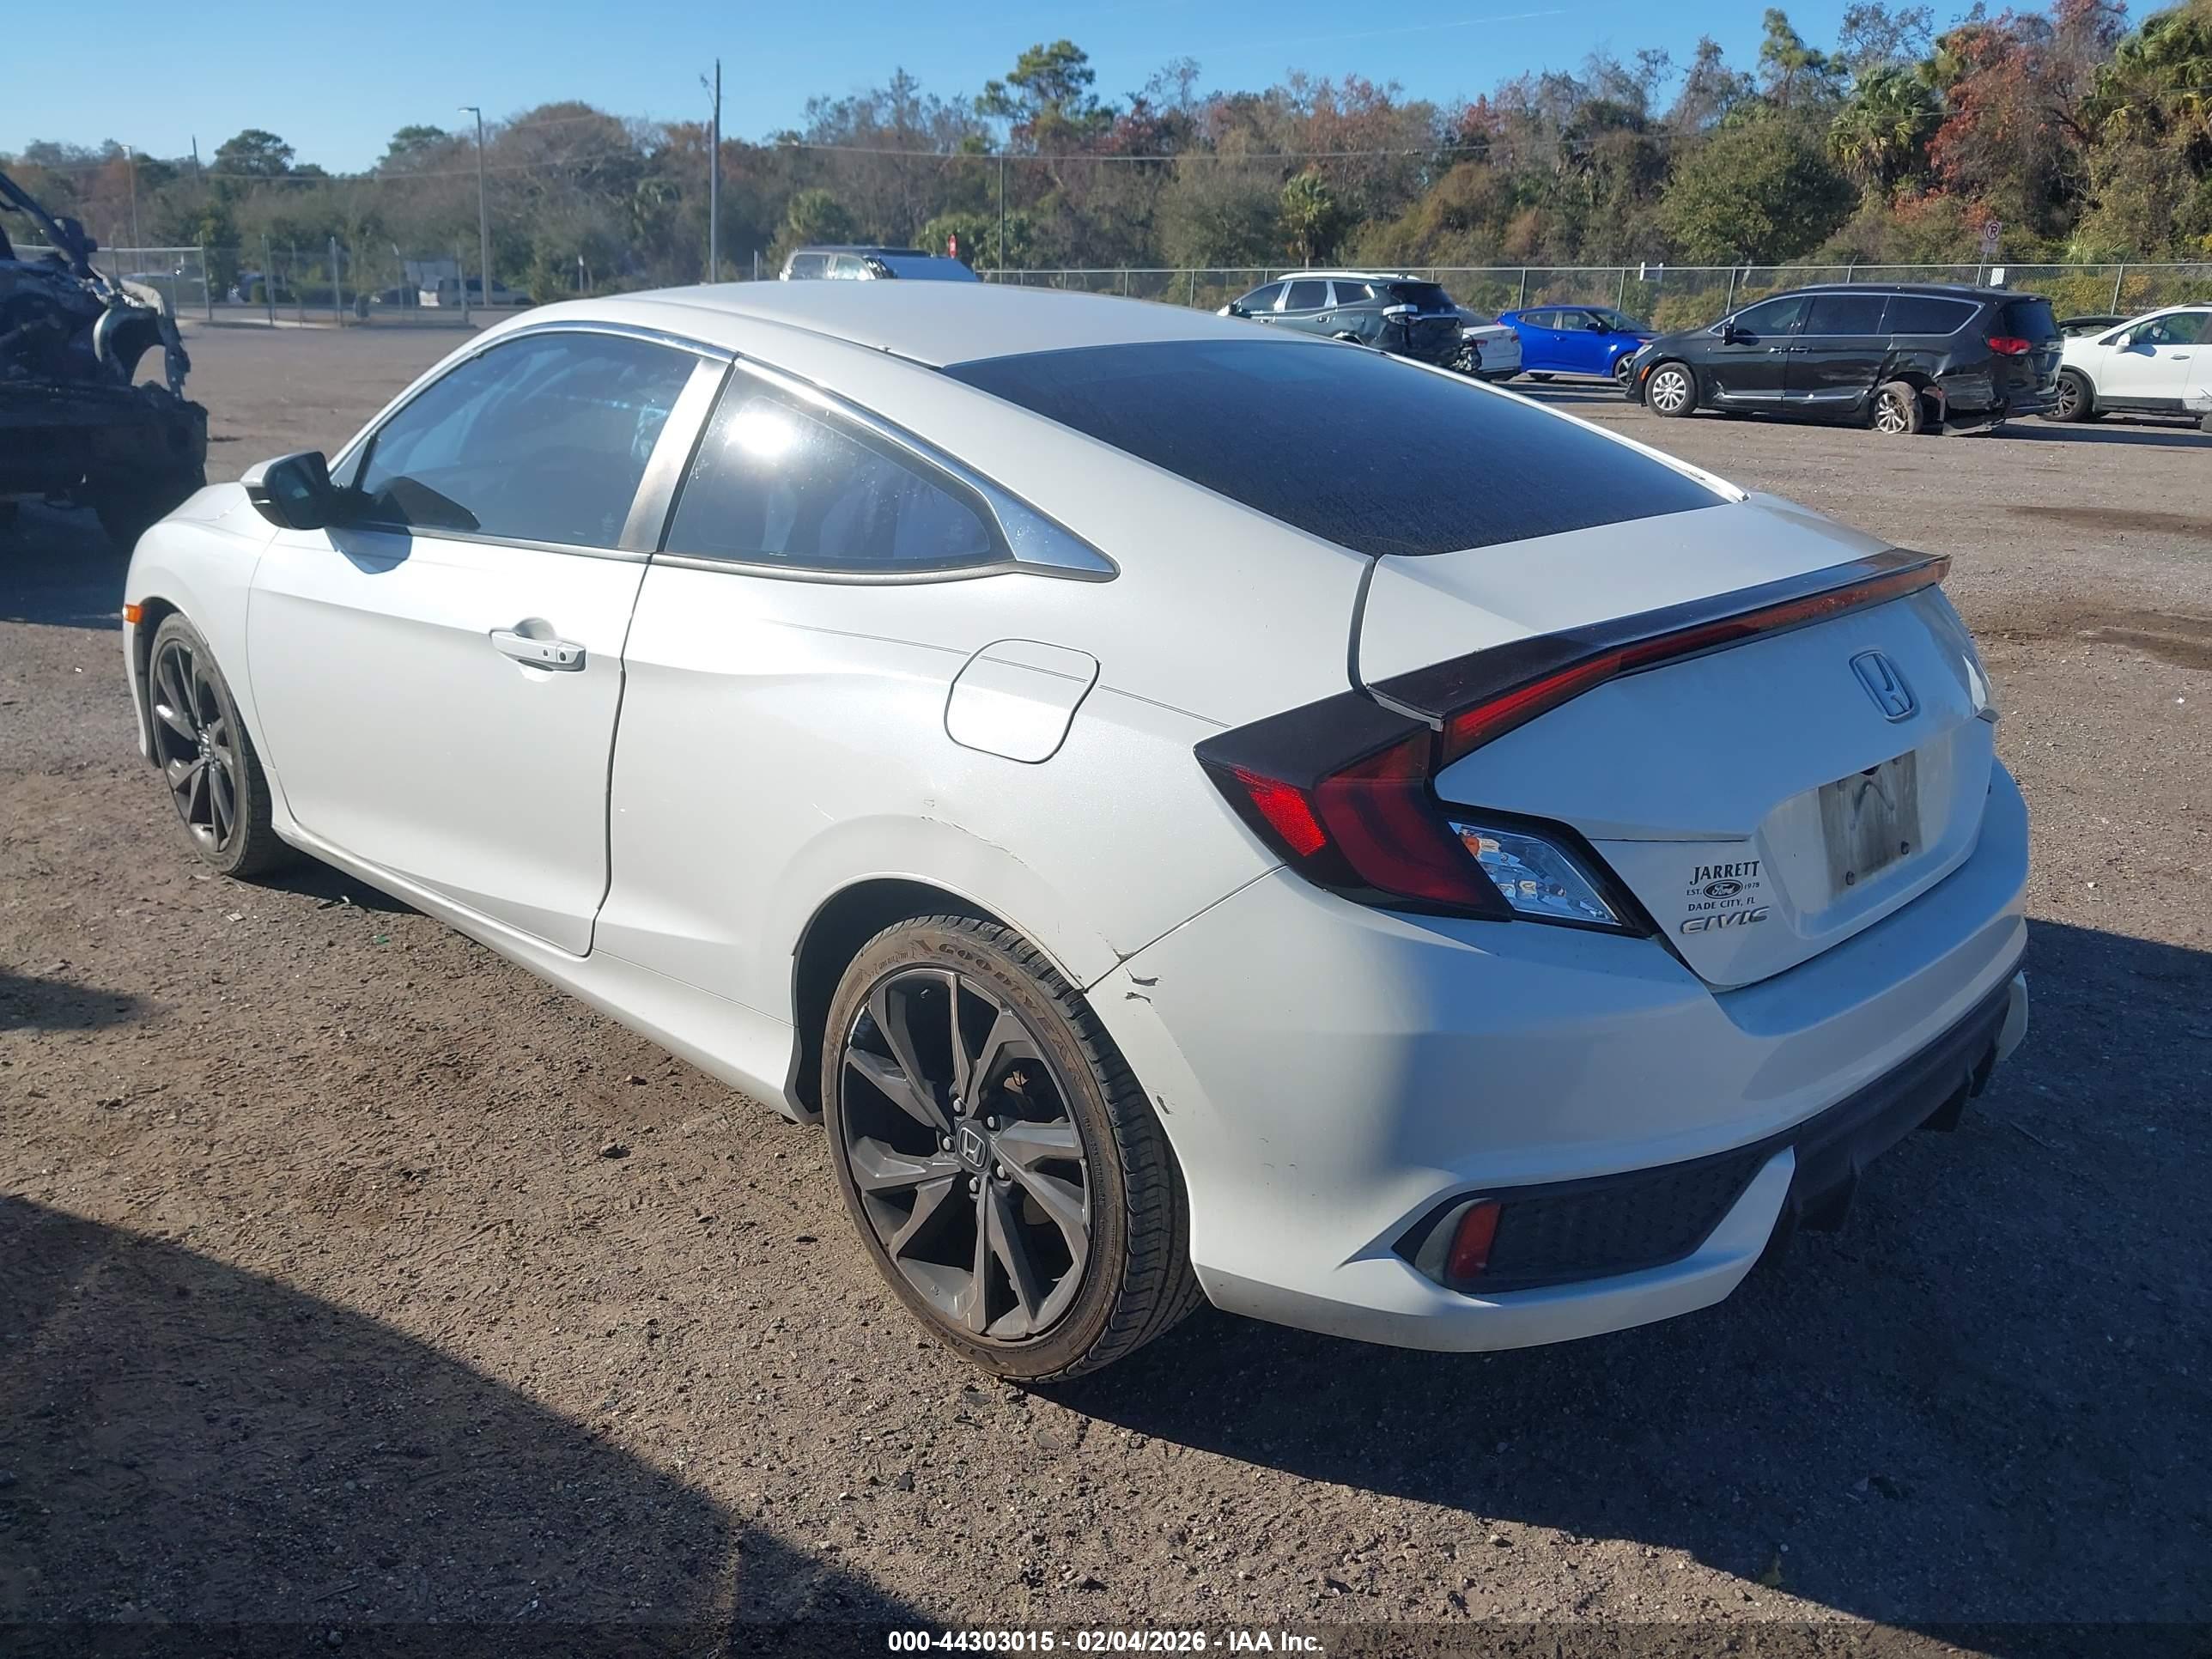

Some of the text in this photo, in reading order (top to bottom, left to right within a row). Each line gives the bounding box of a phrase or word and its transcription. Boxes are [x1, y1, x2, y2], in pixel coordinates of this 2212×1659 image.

[1689, 860, 1759, 885] JARRETT
[1688, 896, 1755, 911] DADE CITY, FL
[1680, 906, 1770, 934] CIVIC
